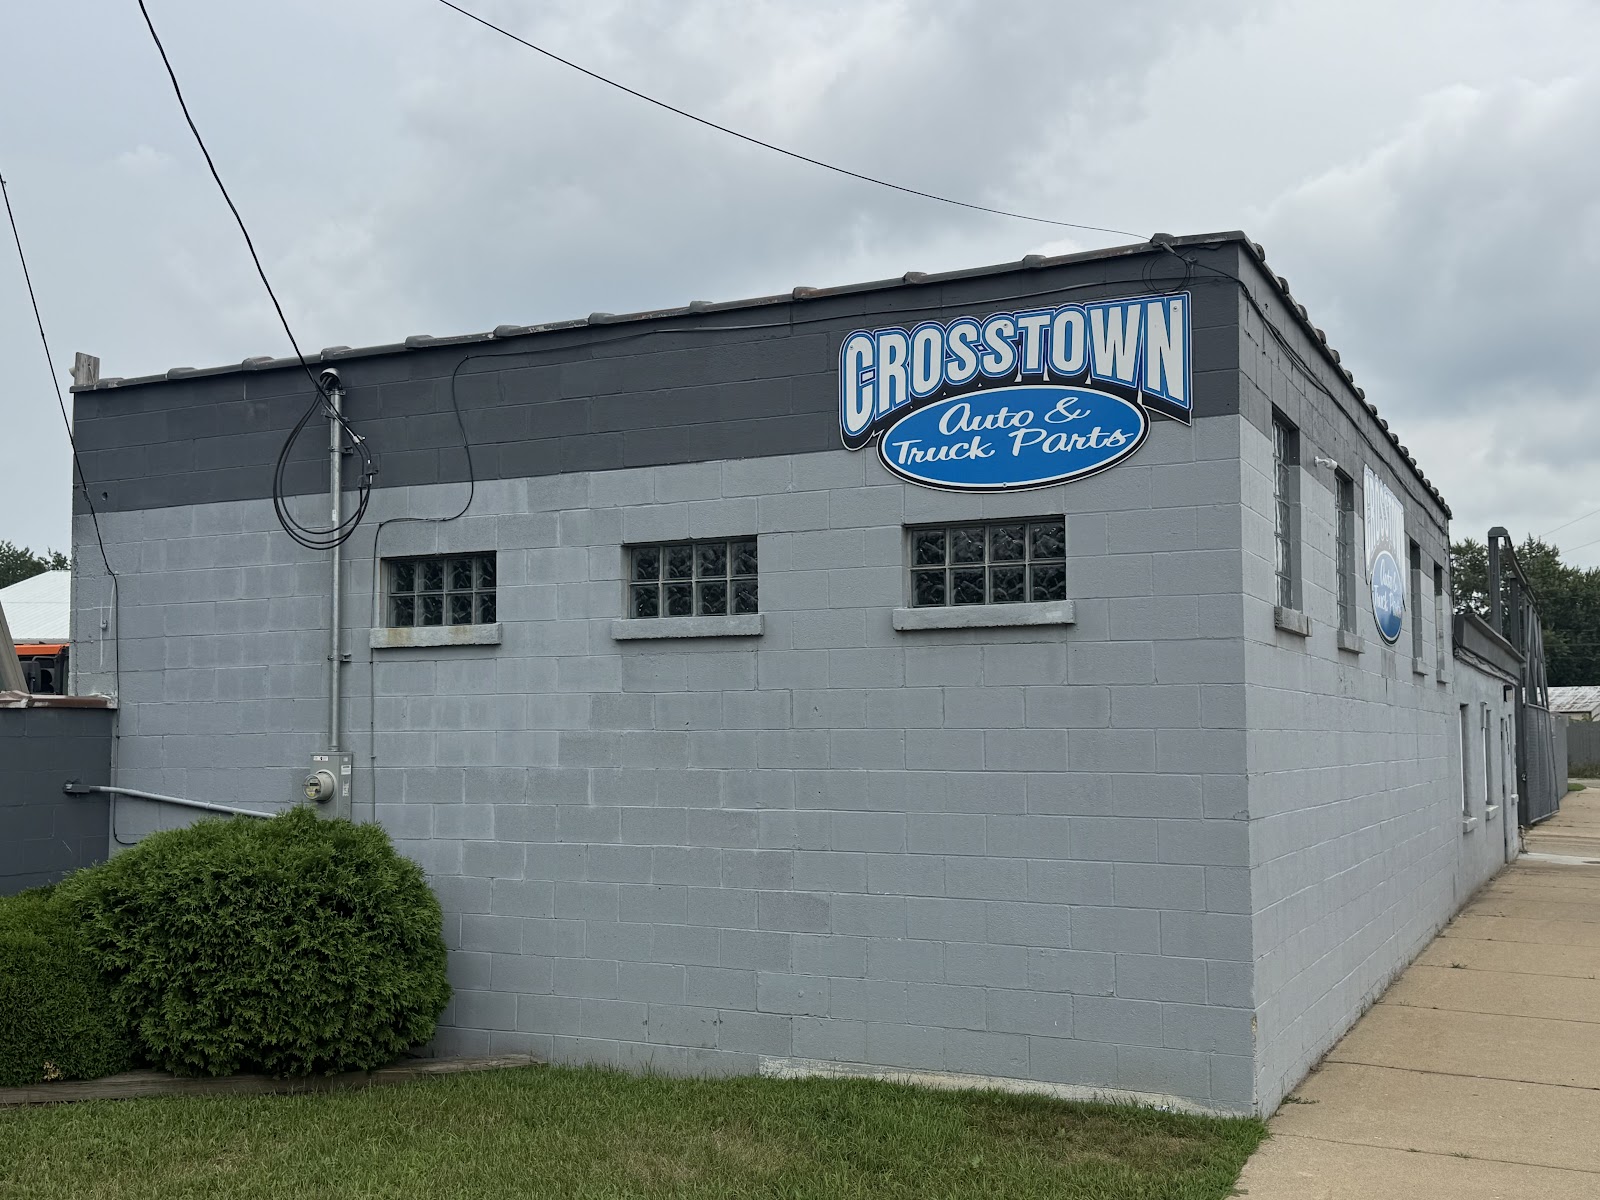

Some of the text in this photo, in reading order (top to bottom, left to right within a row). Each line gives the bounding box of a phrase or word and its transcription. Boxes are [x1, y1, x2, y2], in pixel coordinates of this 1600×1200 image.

[843, 294, 1188, 435] CROSSTOWN
[938, 396, 1092, 436] Auto &
[891, 426, 1135, 466] Truck Parts
